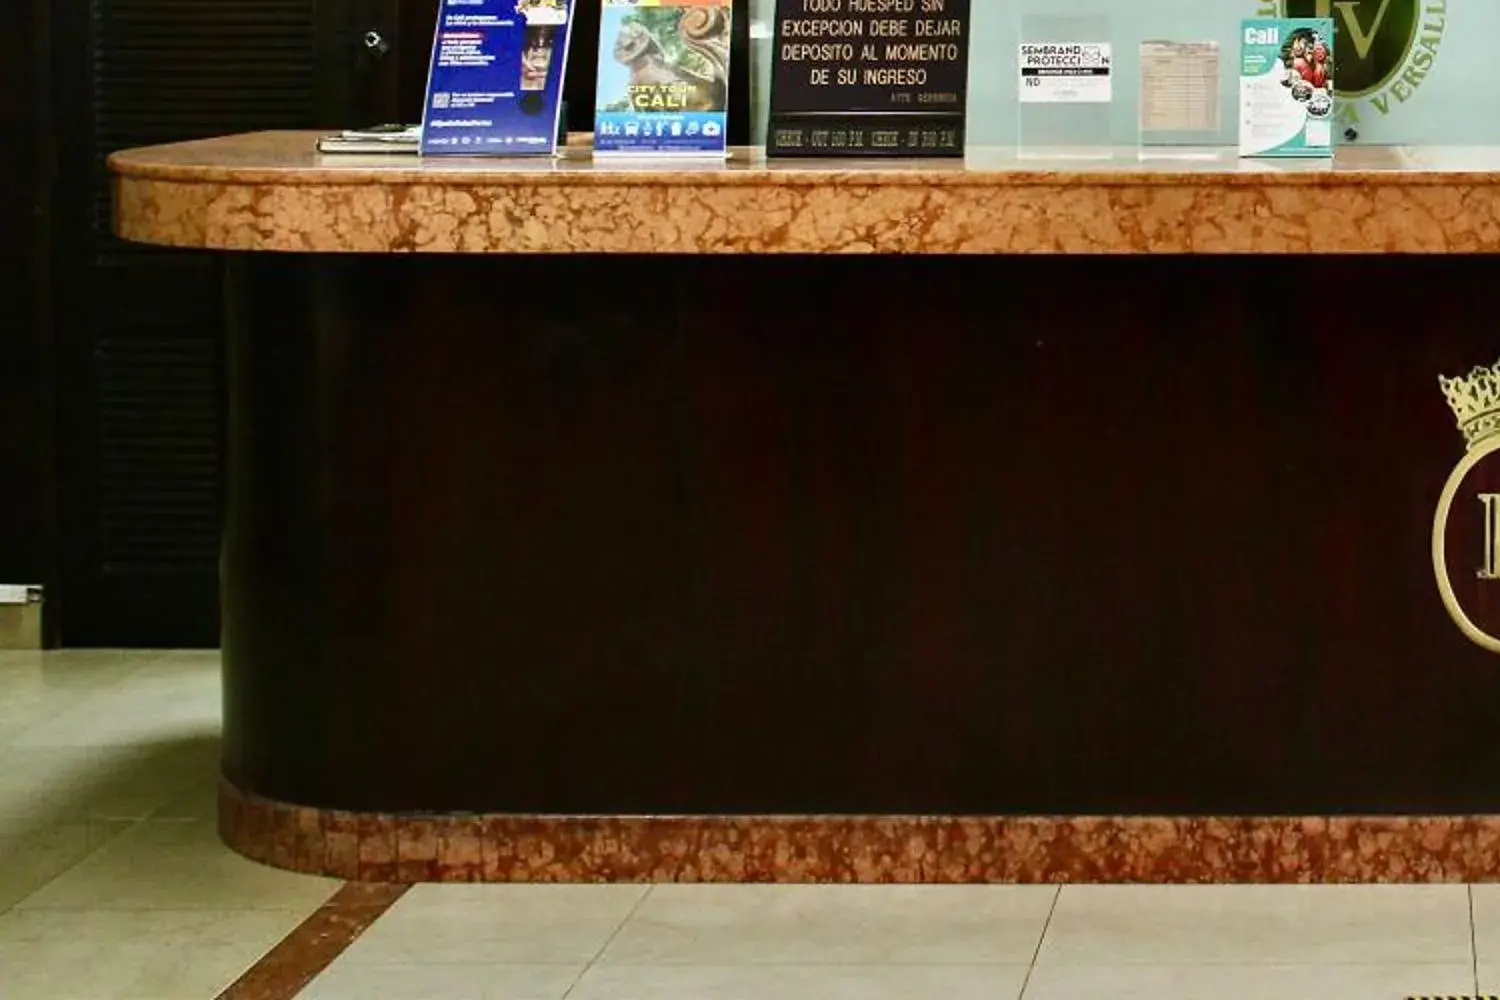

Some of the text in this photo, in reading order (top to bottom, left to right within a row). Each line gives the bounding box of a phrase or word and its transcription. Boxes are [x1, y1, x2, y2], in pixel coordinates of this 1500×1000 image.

[782, 19, 961, 36] EXCEPCION DEBE DEJAR
[781, 43, 958, 61] DEPOSITO AL MOMENTO
[811, 69, 927, 85] DE SU INGRESO
[628, 85, 656, 93] CITY
[635, 95, 688, 107] CALI
